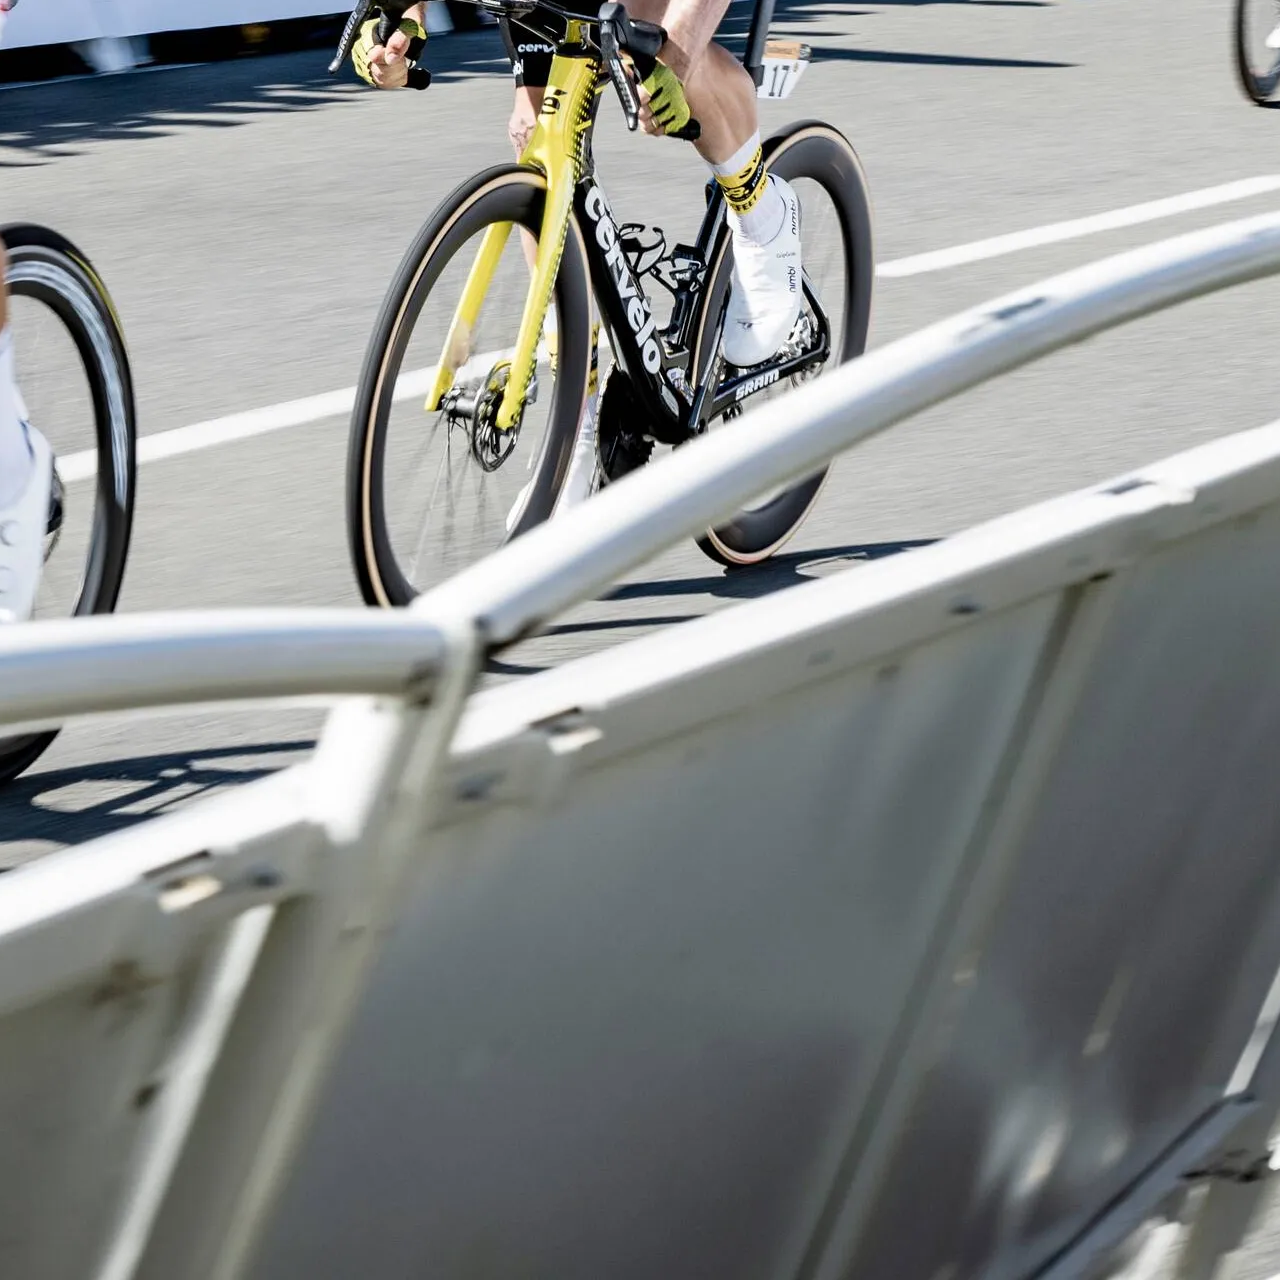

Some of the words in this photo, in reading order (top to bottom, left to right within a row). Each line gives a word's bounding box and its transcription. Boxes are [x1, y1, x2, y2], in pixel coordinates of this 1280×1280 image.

[518, 43, 558, 53] cerv
[769, 65, 790, 97] 17
[585, 185, 661, 374] cervélo
[736, 368, 780, 400] SRAM
